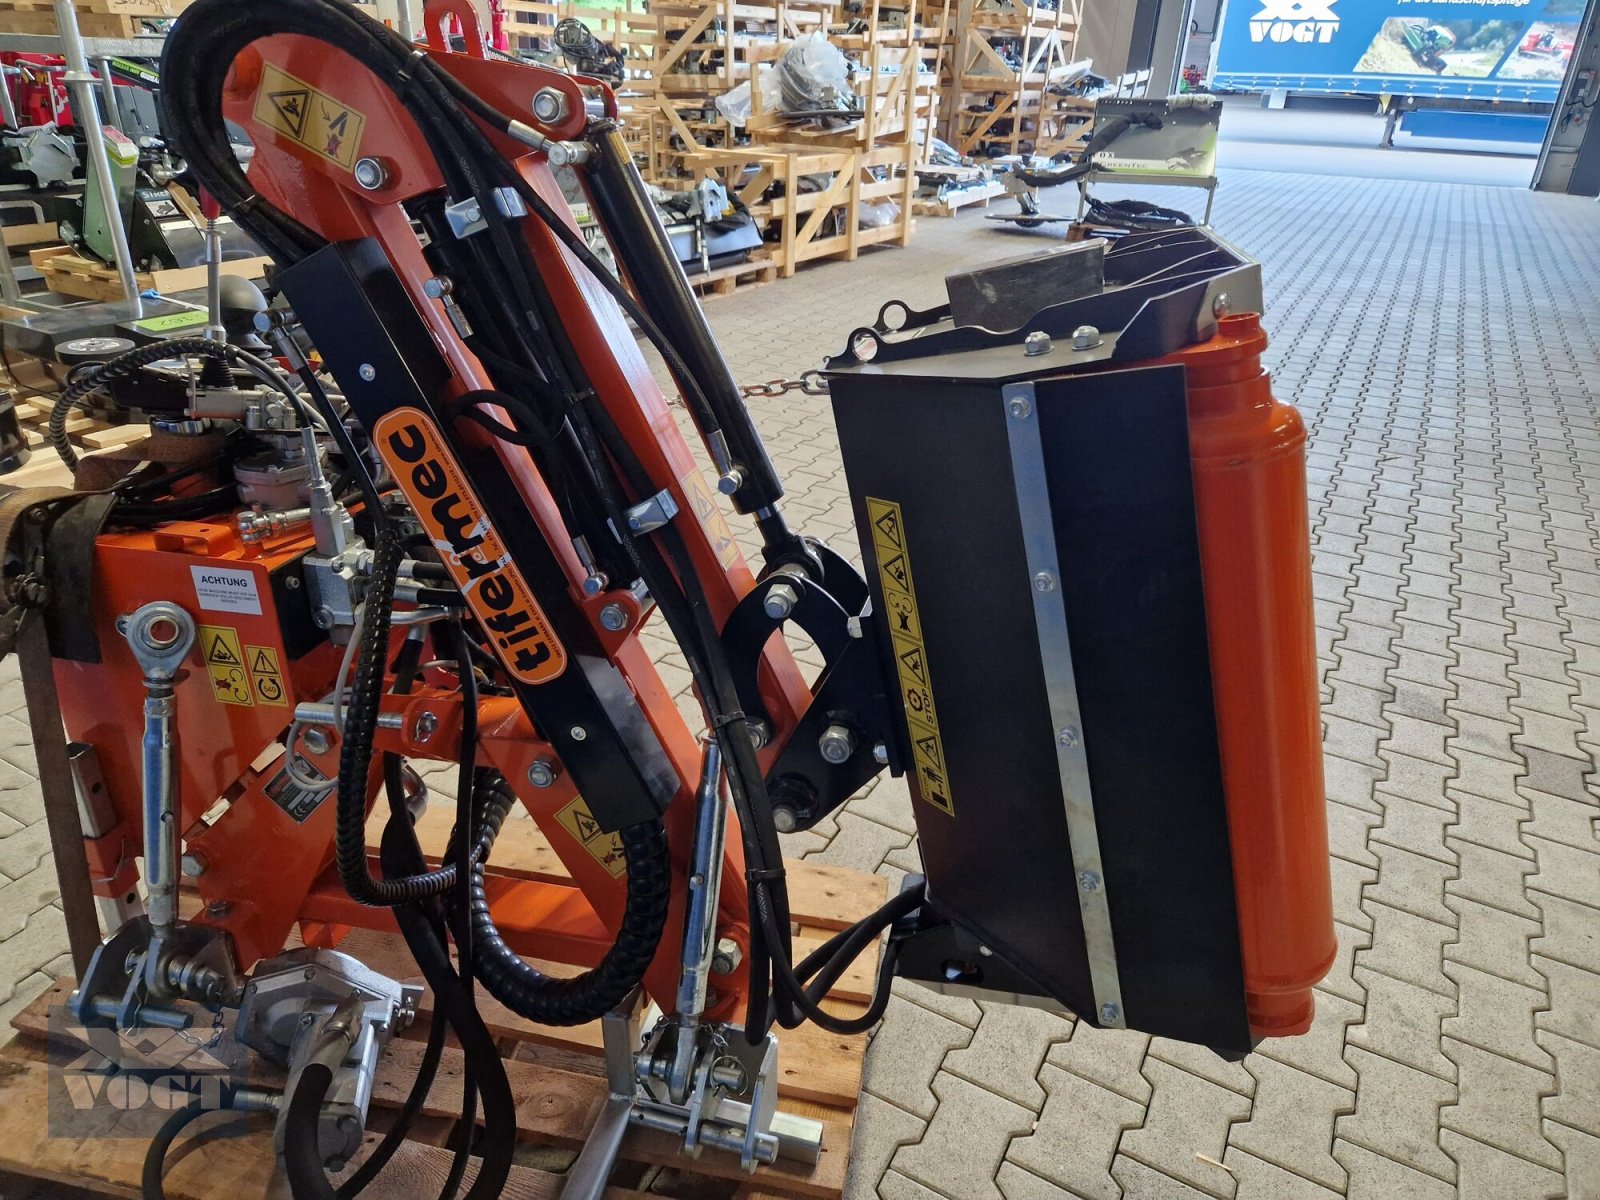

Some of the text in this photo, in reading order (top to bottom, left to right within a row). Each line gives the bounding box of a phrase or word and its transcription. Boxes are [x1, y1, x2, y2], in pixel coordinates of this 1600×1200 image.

[1249, 21, 1340, 44] VOGT
[388, 424, 551, 672] tifermec
[201, 575, 248, 587] ACHTUNG
[264, 685, 277, 693] 540
[921, 688, 934, 724] STOP
